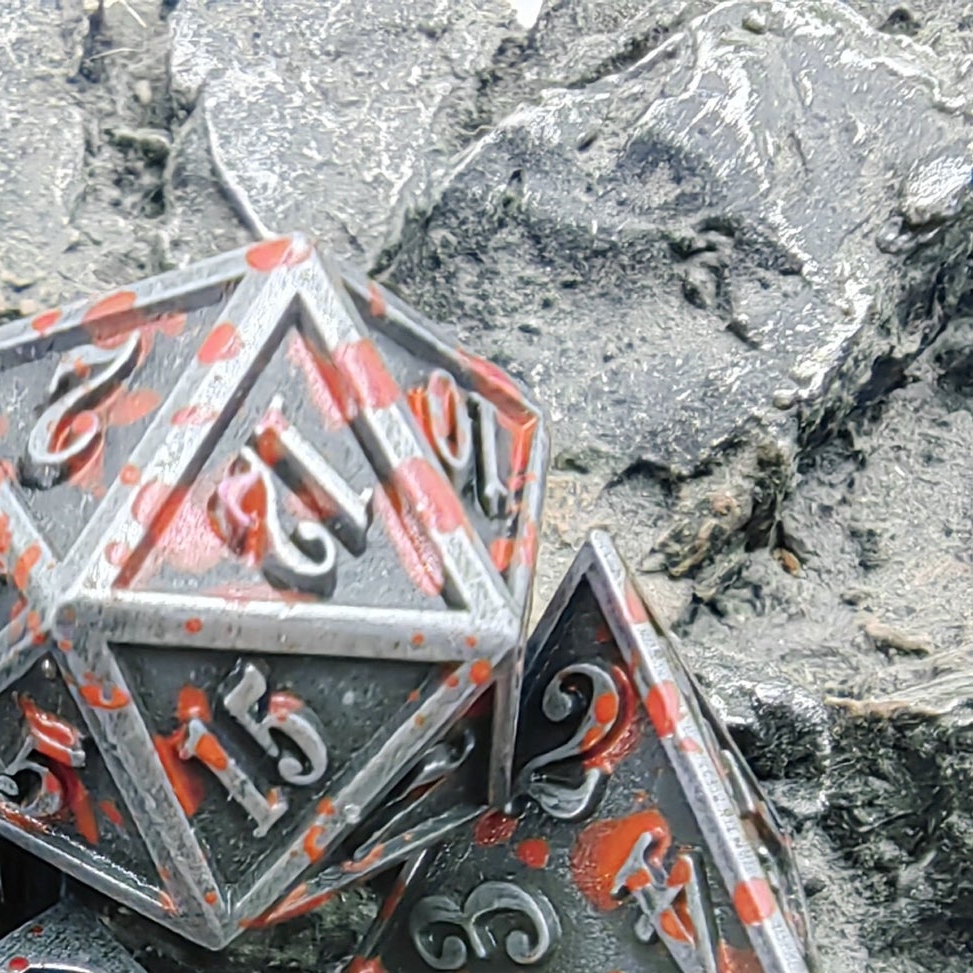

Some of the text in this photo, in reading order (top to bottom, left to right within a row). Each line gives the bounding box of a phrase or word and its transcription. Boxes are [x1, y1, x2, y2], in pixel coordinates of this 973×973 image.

[218, 394, 374, 577] 12
[427, 367, 511, 513] 10
[179, 662, 328, 838] 15
[505, 663, 619, 820] 2
[412, 881, 554, 968] 3
